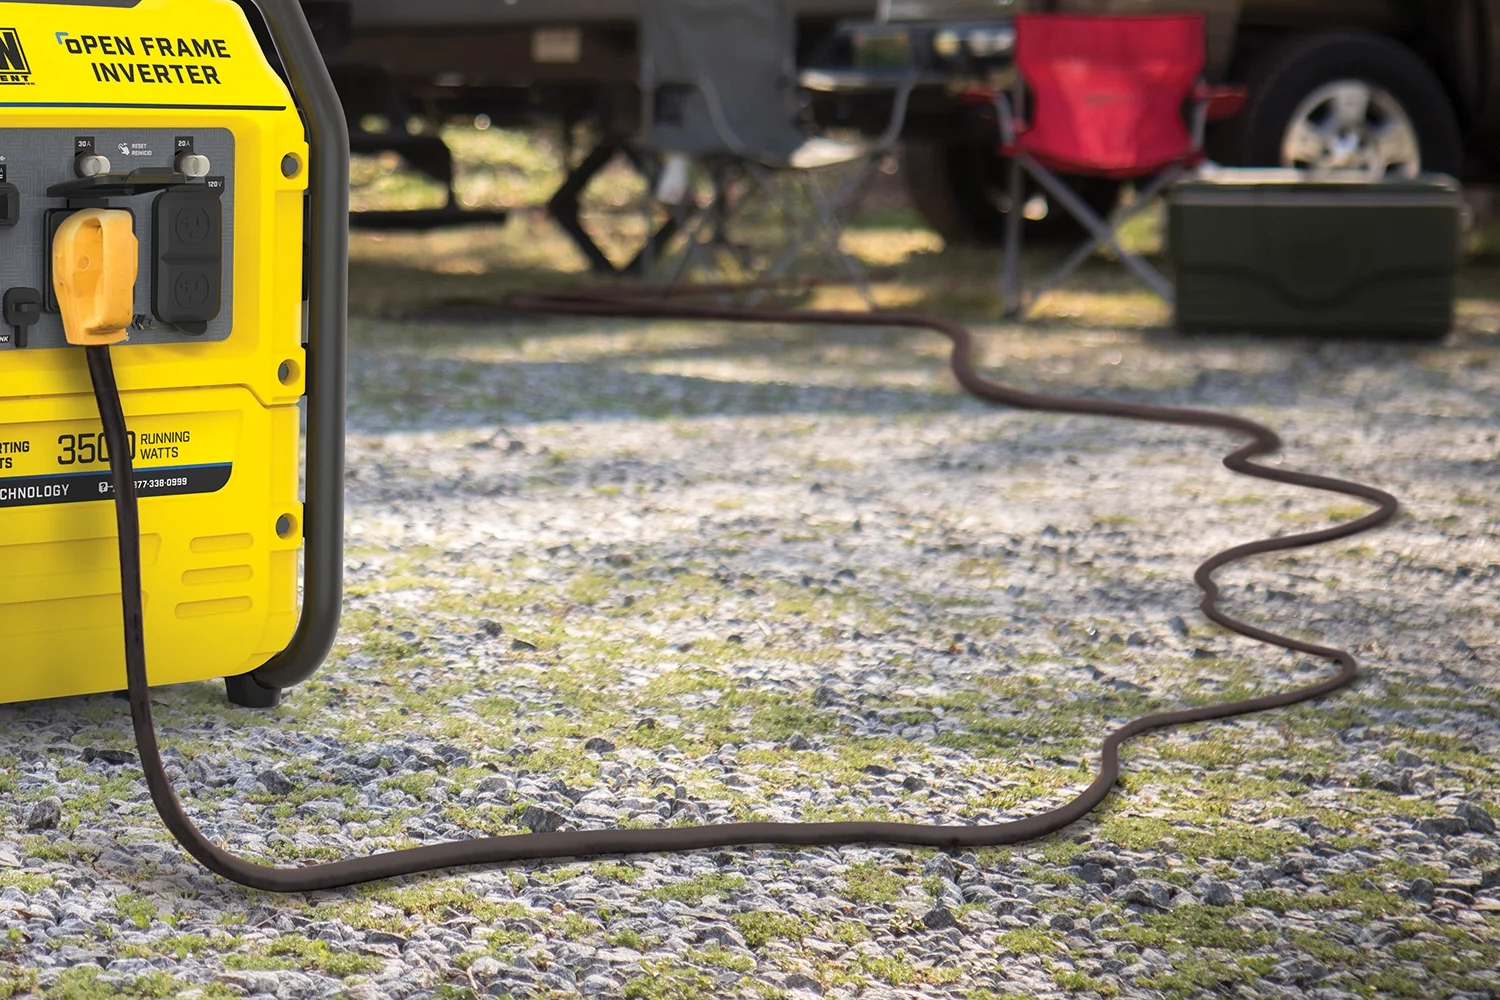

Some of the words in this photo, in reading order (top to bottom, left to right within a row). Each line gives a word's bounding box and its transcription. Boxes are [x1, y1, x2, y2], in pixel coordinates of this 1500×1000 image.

[56, 32, 136, 56] OPEN
[140, 36, 232, 59] FRAME
[91, 62, 222, 85] INVERTER
[140, 430, 190, 445] RUNNING
[140, 446, 179, 460] WATTS
